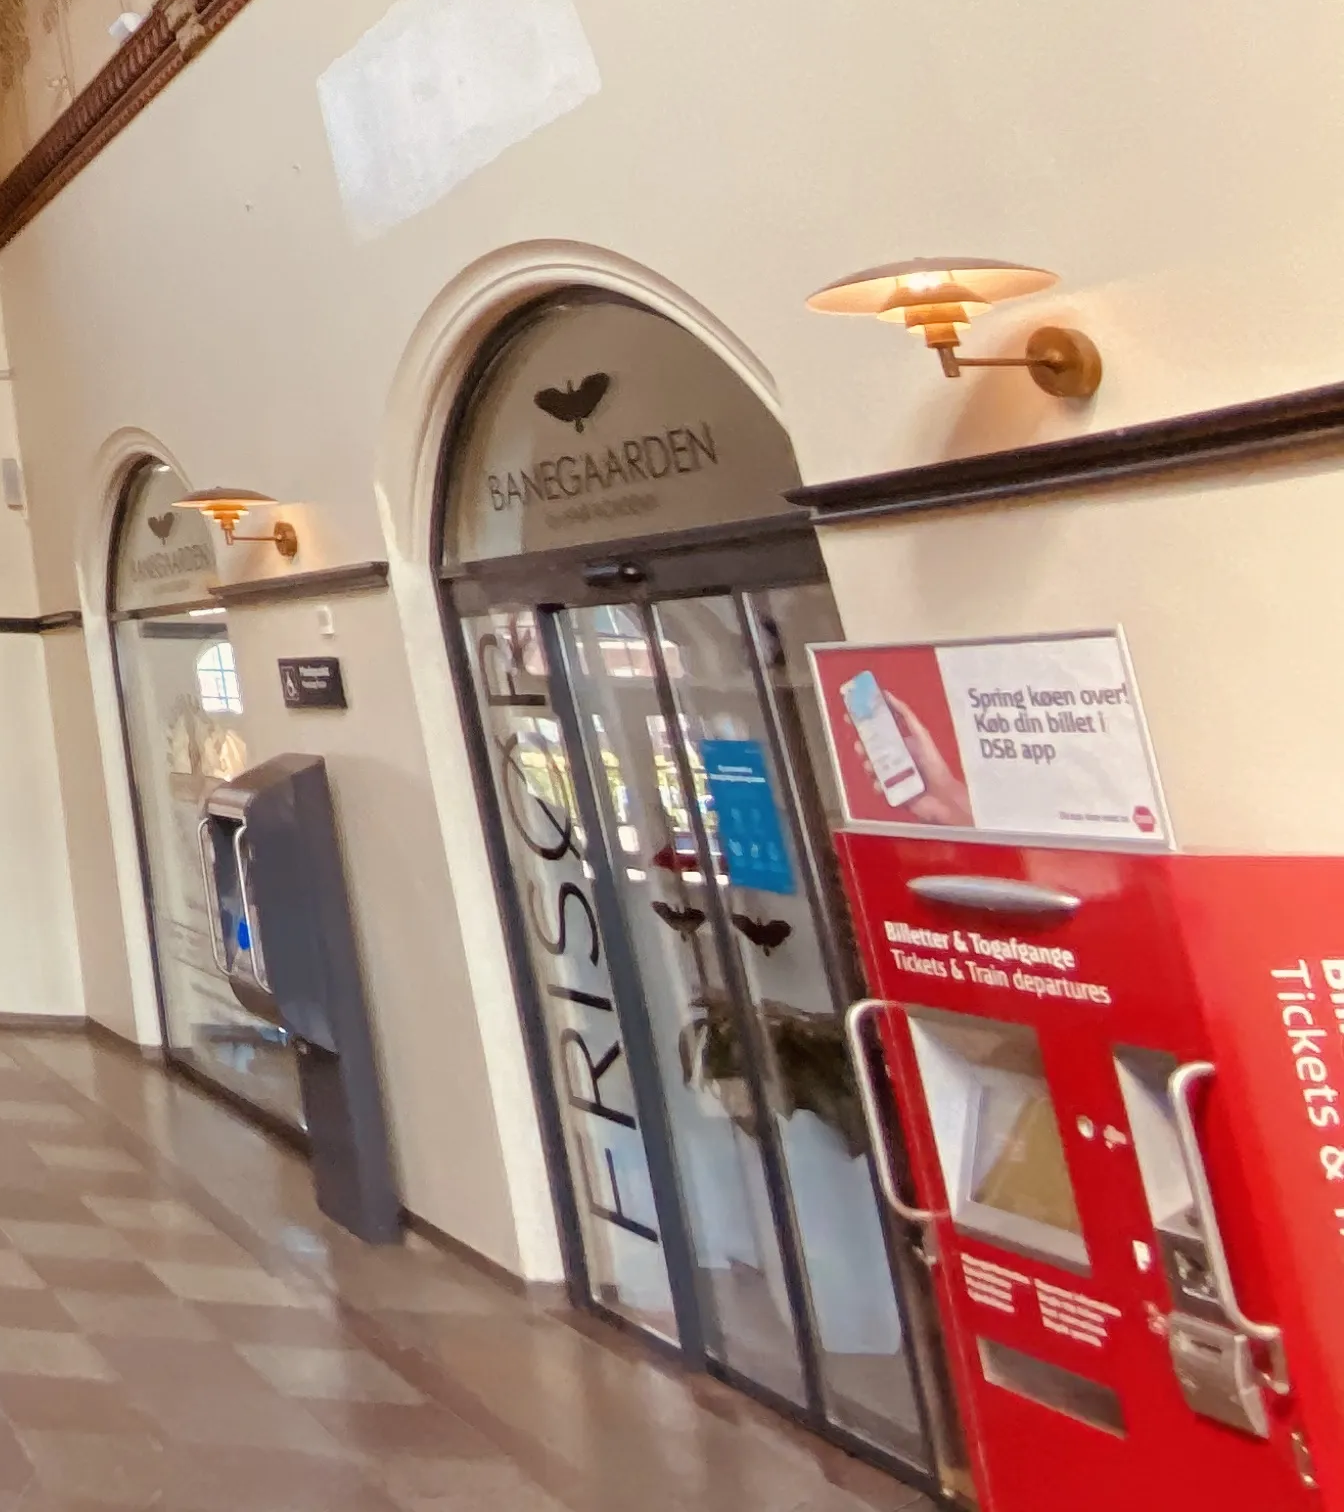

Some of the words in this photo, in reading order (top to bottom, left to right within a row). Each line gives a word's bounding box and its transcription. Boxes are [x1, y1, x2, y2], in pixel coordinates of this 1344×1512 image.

[488, 421, 719, 512] BANEGAARDEN
[968, 687, 1027, 713] Spring
[1027, 685, 1076, 706] køen
[1080, 682, 1130, 706] over!
[974, 712, 1010, 733] Køb
[1014, 711, 1044, 733] din
[1045, 711, 1096, 734] billet
[1097, 711, 1106, 733] i
[980, 738, 1018, 759] DSB
[1021, 743, 1057, 765] app
[884, 920, 949, 950] Billetter
[953, 931, 969, 953] &
[968, 932, 1075, 971] Togafgange
[890, 948, 948, 978] Tickets
[950, 959, 965, 981] &
[965, 960, 1010, 988] Train
[1012, 968, 1111, 1004] departures
[1270, 958, 1340, 1128] Tickets
